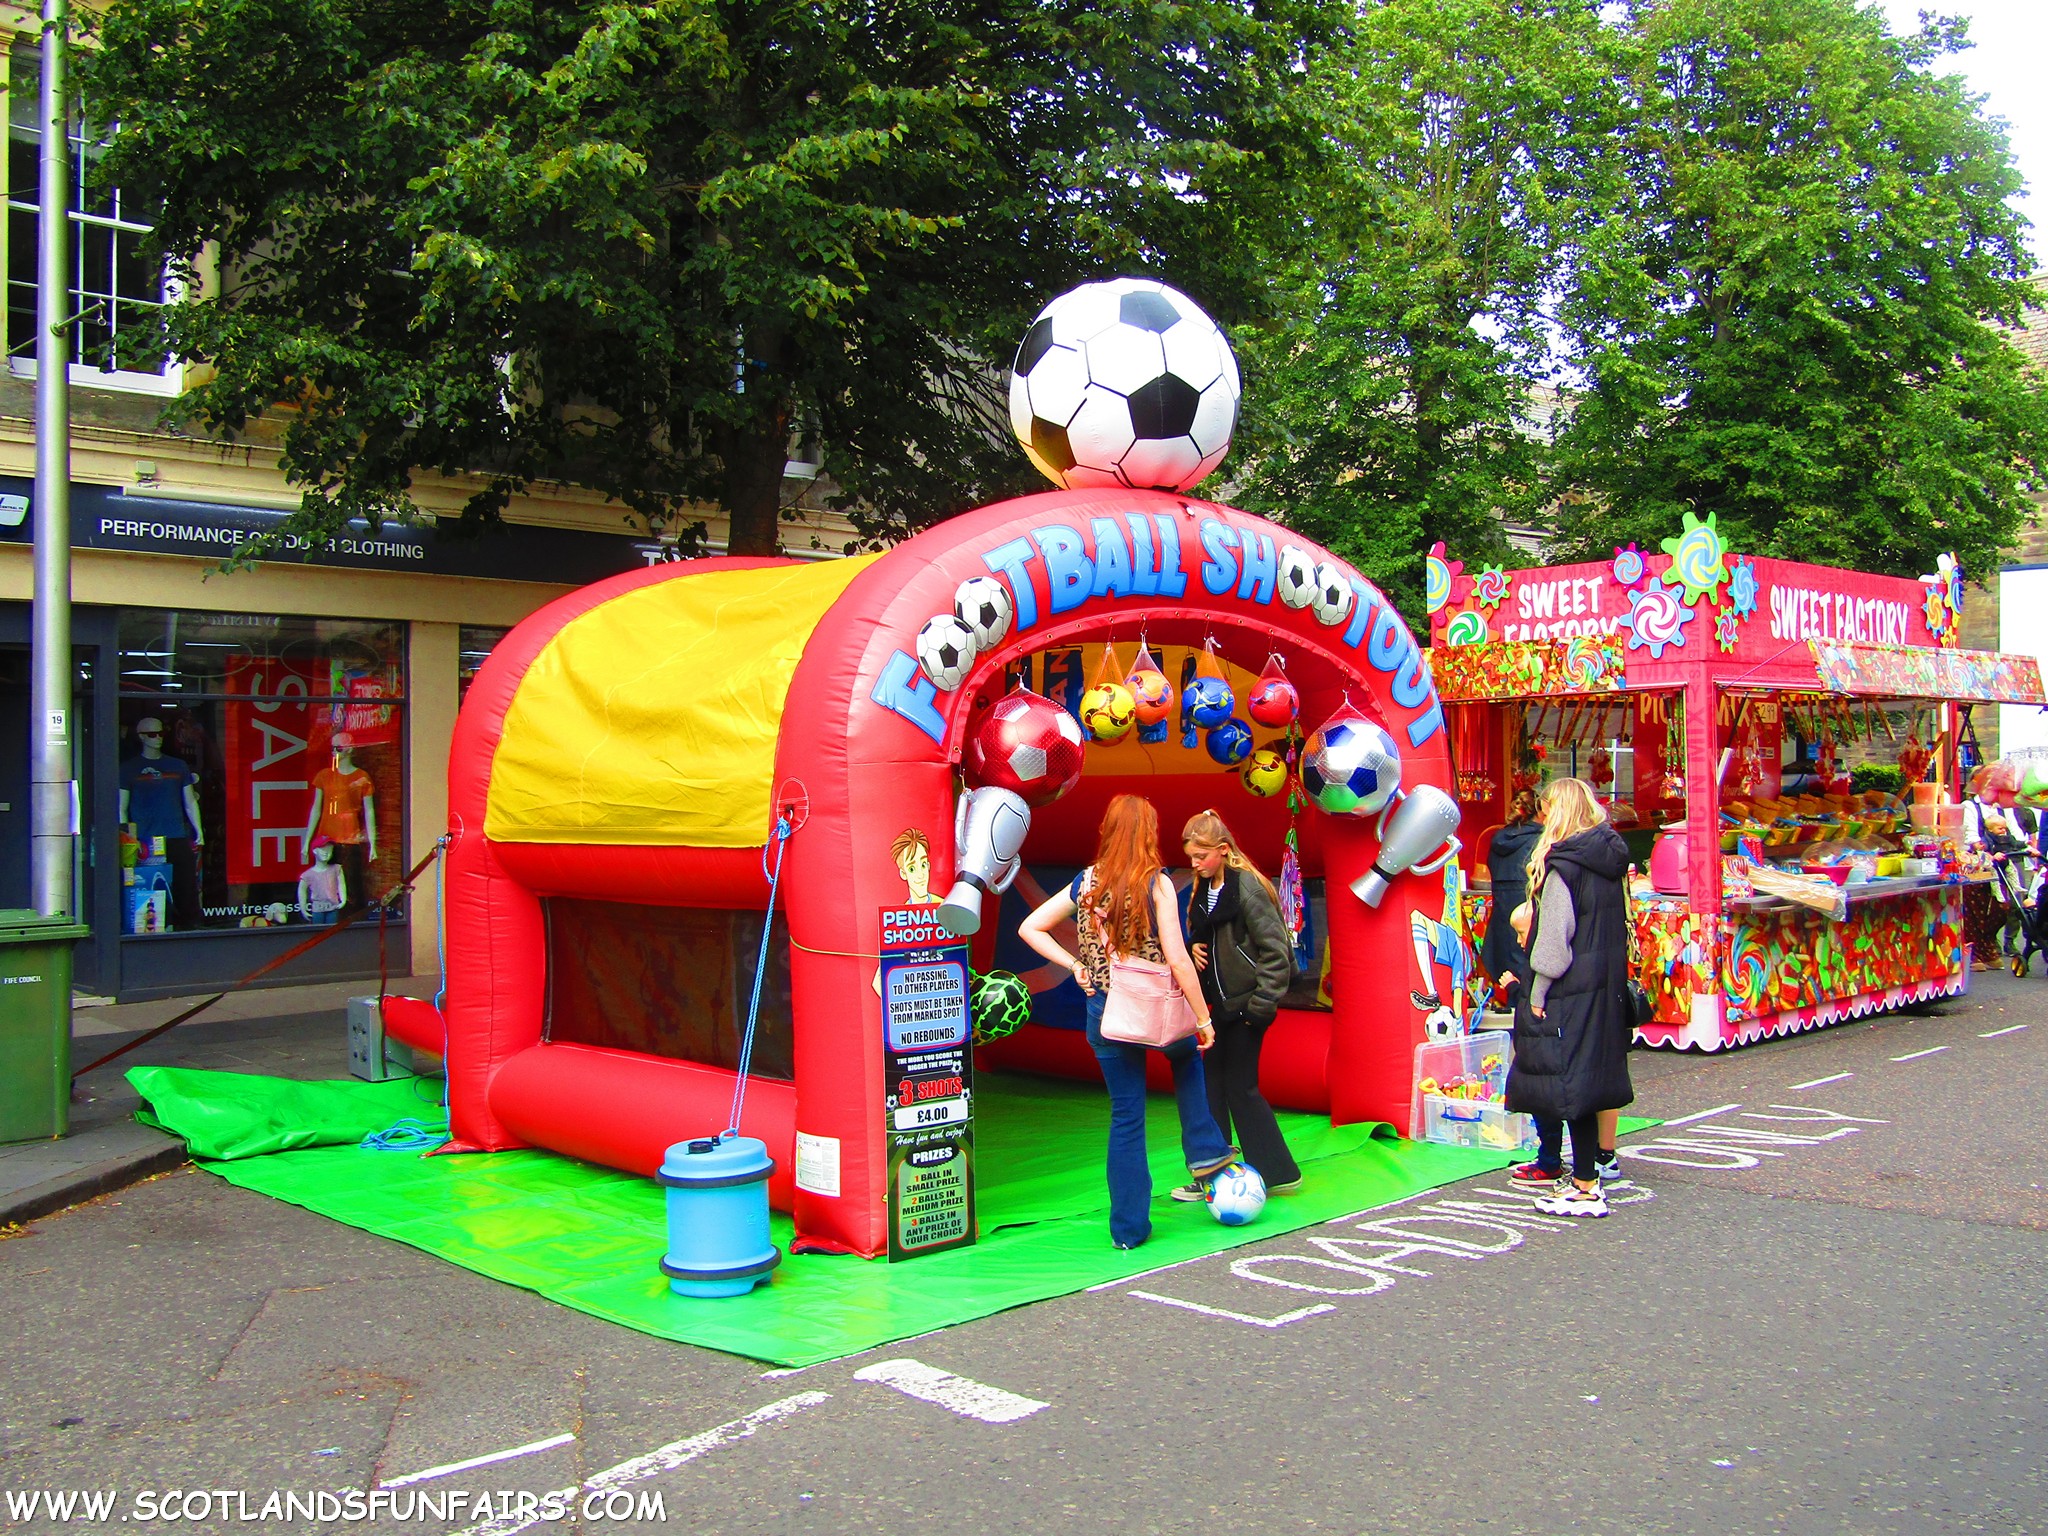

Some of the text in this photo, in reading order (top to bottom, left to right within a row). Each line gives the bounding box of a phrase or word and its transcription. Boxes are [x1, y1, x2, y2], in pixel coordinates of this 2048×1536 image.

[100, 518, 243, 545] PERFORMANCE
[341, 538, 424, 559] CLOTHING
[1518, 576, 1603, 619] SWEET
[1770, 584, 1909, 644] SWEET FACTORY
[52, 715, 63, 725] 19
[251, 673, 309, 867] SALE
[883, 909, 940, 927] PENAL
[883, 926, 961, 944] SHOOT OU
[904, 970, 948, 983] NO PASSING
[893, 979, 959, 995] TO OTHER PLAYERS
[890, 996, 963, 1013] SHOTS MUST BE TAKEN
[893, 1007, 960, 1024] FROM MARKED SPOT
[901, 1027, 955, 1044] NO REBOUNDS
[908, 1056, 923, 1064] MORE
[935, 1052, 952, 1060] SCORE
[907, 1063, 927, 1071] BIGGER
[899, 1077, 963, 1106] 3 SHOTS
[917, 1107, 948, 1123] £4.00
[895, 1124, 967, 1146] Have fun and enjoy!
[1616, 1104, 1892, 1170] ONLY
[912, 1147, 952, 1164] PRIZES
[906, 1176, 960, 1193] SMALL PRIZE
[921, 1171, 941, 1181] BALL
[903, 1196, 964, 1215] MEDIUM PRIZE
[919, 1192, 944, 1203] BALLS
[919, 1212, 945, 1225] BALLS
[905, 1227, 963, 1245] YOUR CHOICE
[906, 1227, 924, 1237] ANY
[925, 1221, 949, 1233] PRIZE
